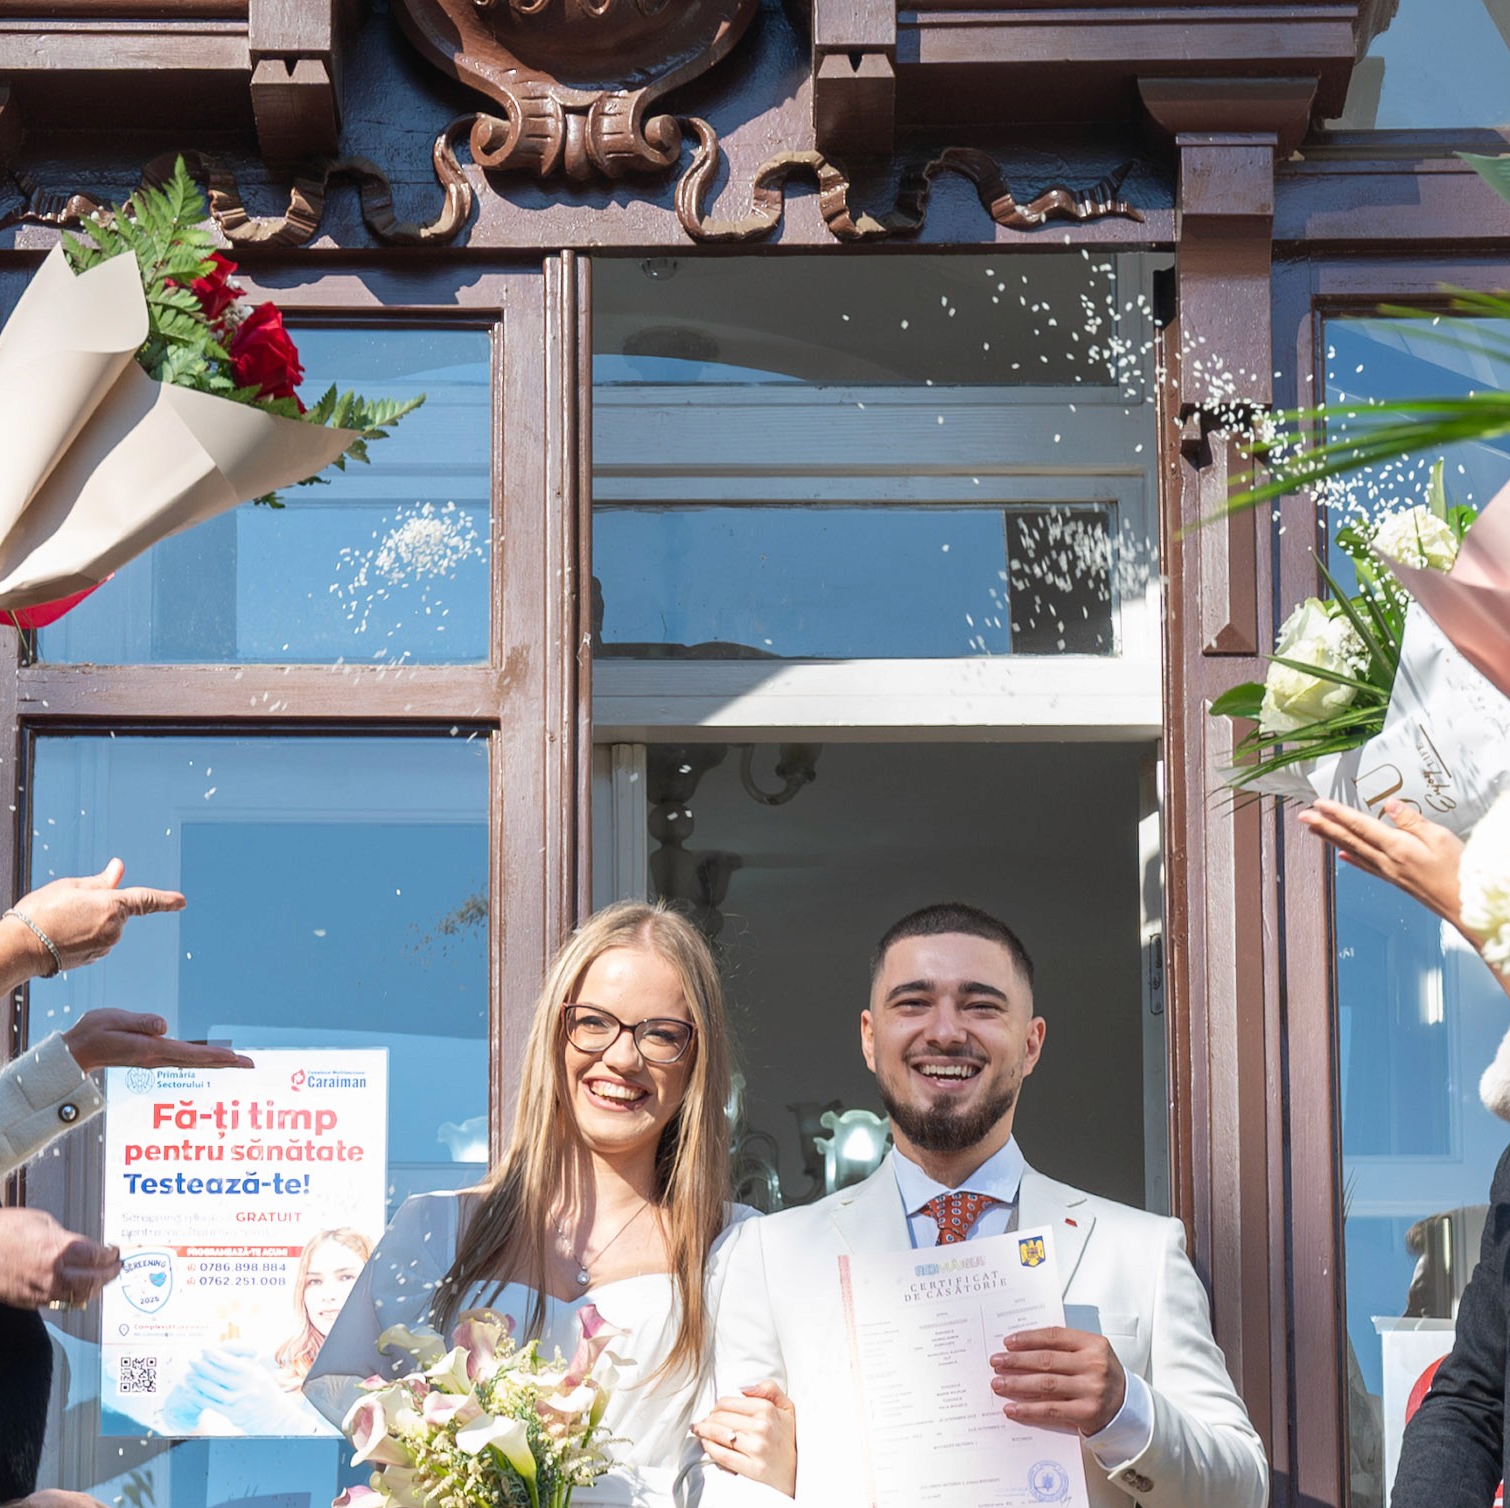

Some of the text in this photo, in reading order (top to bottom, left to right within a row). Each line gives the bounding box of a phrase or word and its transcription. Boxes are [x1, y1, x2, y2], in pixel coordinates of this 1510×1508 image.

[157, 1080, 204, 1089] Sectorului
[307, 1075, 367, 1089] Caraiman
[248, 1100, 338, 1136] timp
[125, 1138, 364, 1165] pentru sănătate
[123, 1171, 310, 1195] Testează-te!
[235, 1211, 303, 1223] GRATUIT
[122, 1259, 166, 1273] SCREENING
[199, 1262, 287, 1273] 0786.898.884
[199, 1276, 287, 1286] 0762.251.008
[909, 1270, 999, 1292] CERTIFICAT
[904, 1293, 921, 1302] DE
